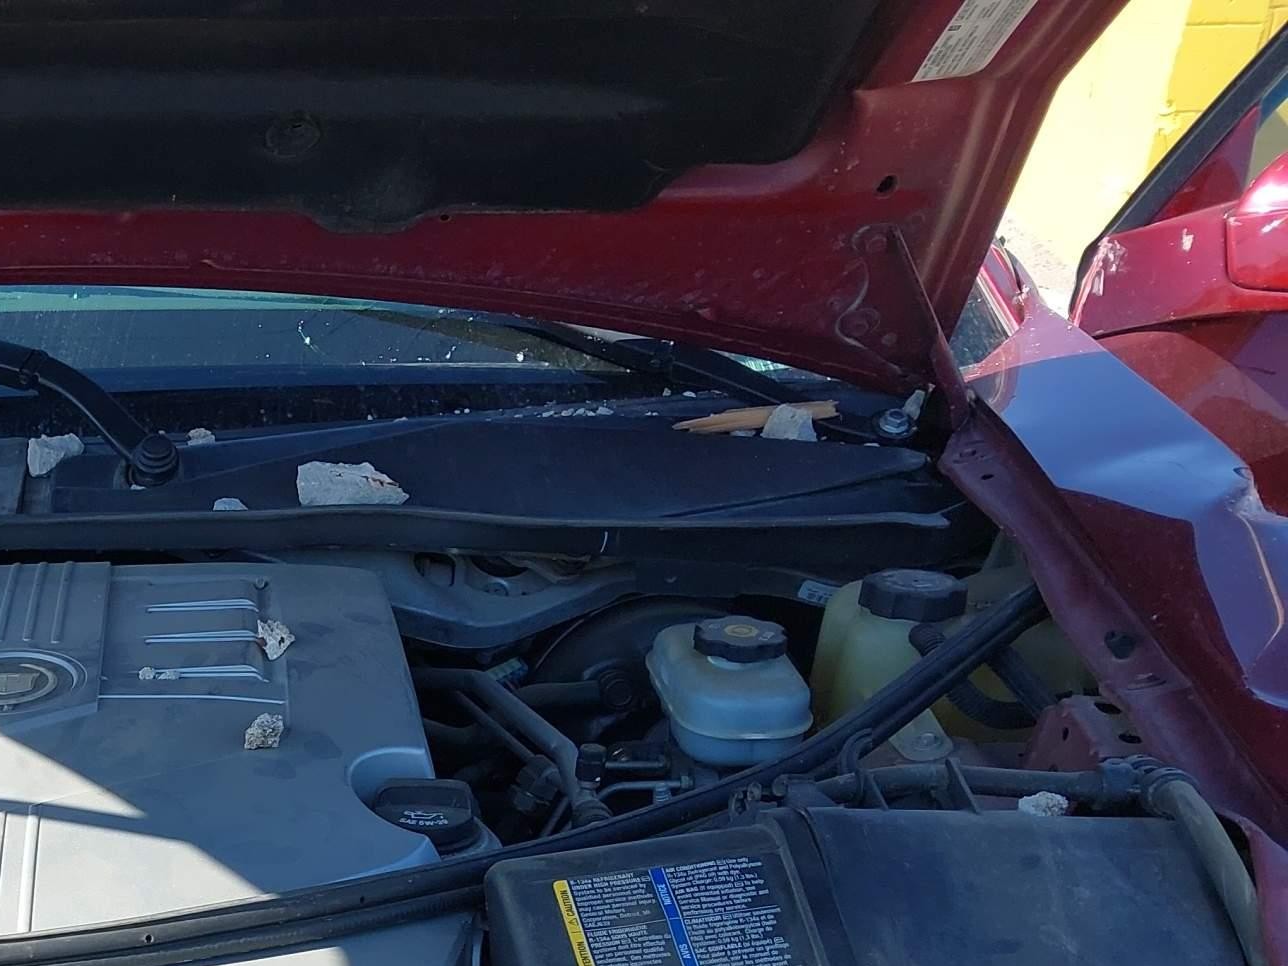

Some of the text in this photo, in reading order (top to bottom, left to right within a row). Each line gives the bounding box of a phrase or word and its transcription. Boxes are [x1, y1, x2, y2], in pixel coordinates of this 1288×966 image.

[560, 890, 575, 916] CAUTION
[658, 884, 672, 906] NOTICE
[679, 944, 691, 959] AVIS
